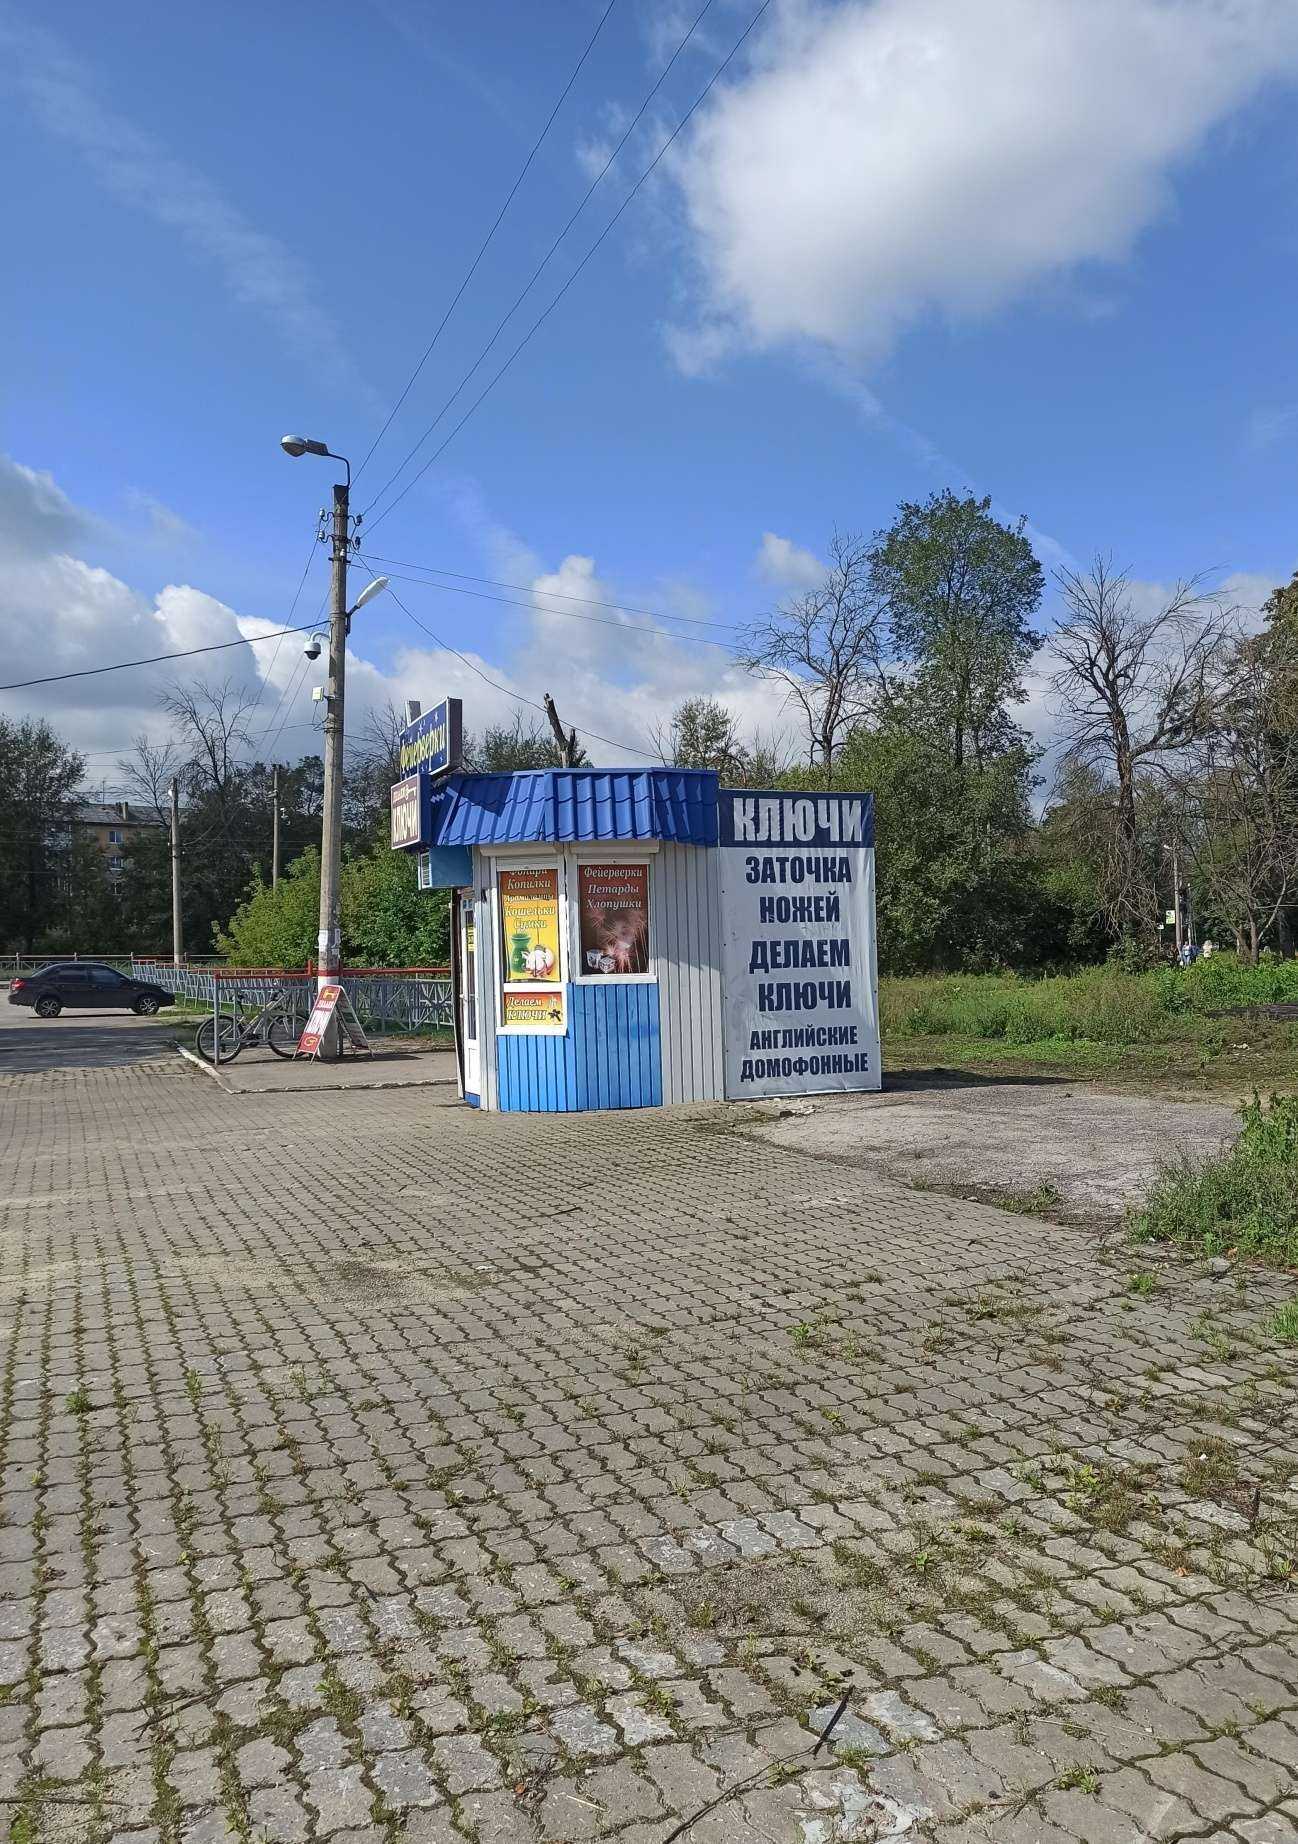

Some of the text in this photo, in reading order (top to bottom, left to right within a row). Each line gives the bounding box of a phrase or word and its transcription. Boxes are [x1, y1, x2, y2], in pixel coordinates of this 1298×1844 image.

[733, 797, 863, 842] КЛЮЧИ
[507, 878, 552, 890] Копилки
[584, 866, 643, 880] Фейерверки
[745, 856, 853, 884] ЗАТОЧКА
[588, 883, 640, 896] Петарды
[504, 906, 556, 917] Кошельки
[586, 899, 642, 911] Хлопушки
[759, 890, 841, 924] НОЖЕЙ
[749, 938, 851, 975] ДЕЛАЕМ
[506, 996, 543, 1009] Делаем
[758, 980, 852, 1012] КЛЮЧИ
[750, 1023, 858, 1051] АНГЛИЙСКИЕ
[740, 1052, 869, 1083] ДОМОФОННЫЕ
